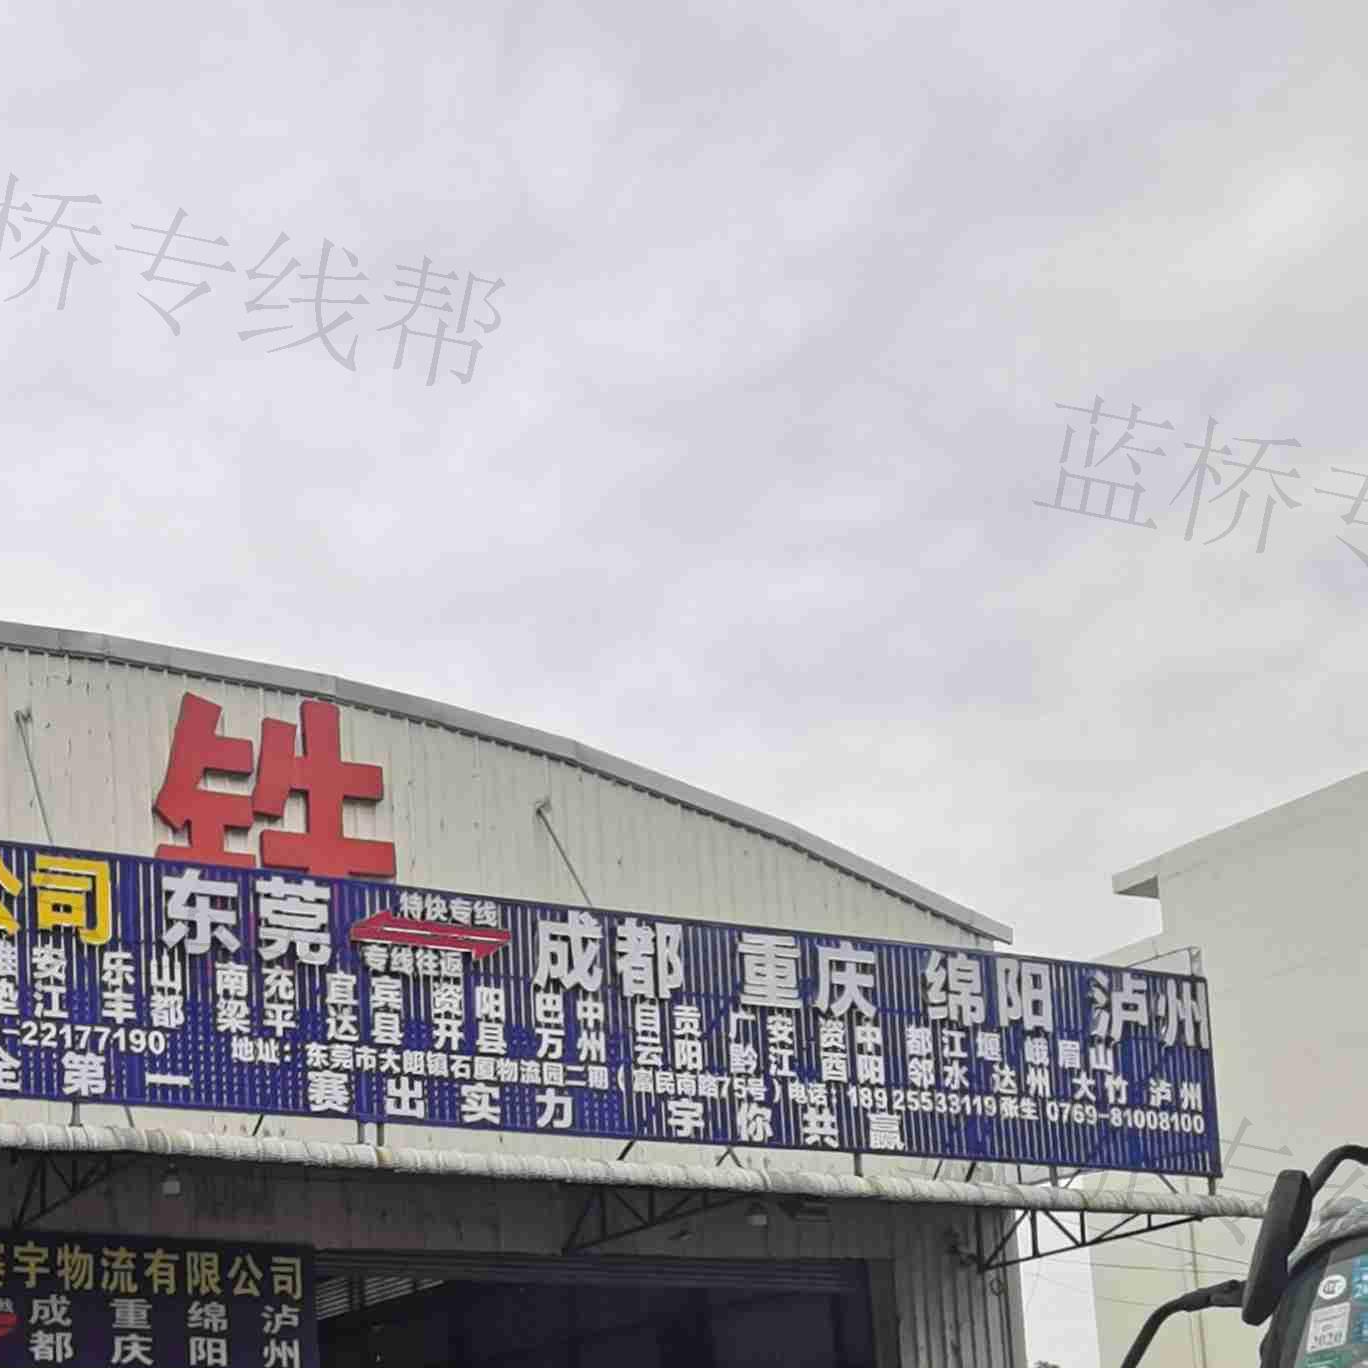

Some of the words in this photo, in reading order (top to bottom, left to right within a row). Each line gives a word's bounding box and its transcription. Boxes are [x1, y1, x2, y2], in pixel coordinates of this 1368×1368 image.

[161, 869, 332, 966] 东莞
[399, 891, 498, 927] 特快专线
[103, 951, 181, 989] 乐山
[216, 962, 294, 1000] 南充
[364, 944, 462, 978] 专线往返
[533, 910, 683, 1000] 成都
[737, 931, 878, 1018] 重庆
[921, 950, 1053, 1032] 绵阳
[1089, 966, 1210, 1050] 泸州
[102, 988, 183, 1028] 丰都
[216, 1000, 296, 1037] 梁平
[535, 1028, 605, 1062] 万州
[992, 1064, 1050, 1098] 达州
[1073, 1073, 1128, 1104] 大竹
[307, 1071, 573, 1129] 赛出实力
[1046, 1102, 1205, 1134] 0769-81008100
[28, 1293, 74, 1364] 成都
[109, 1297, 154, 1366] 重庆
[186, 1300, 229, 1368] 绵阳
